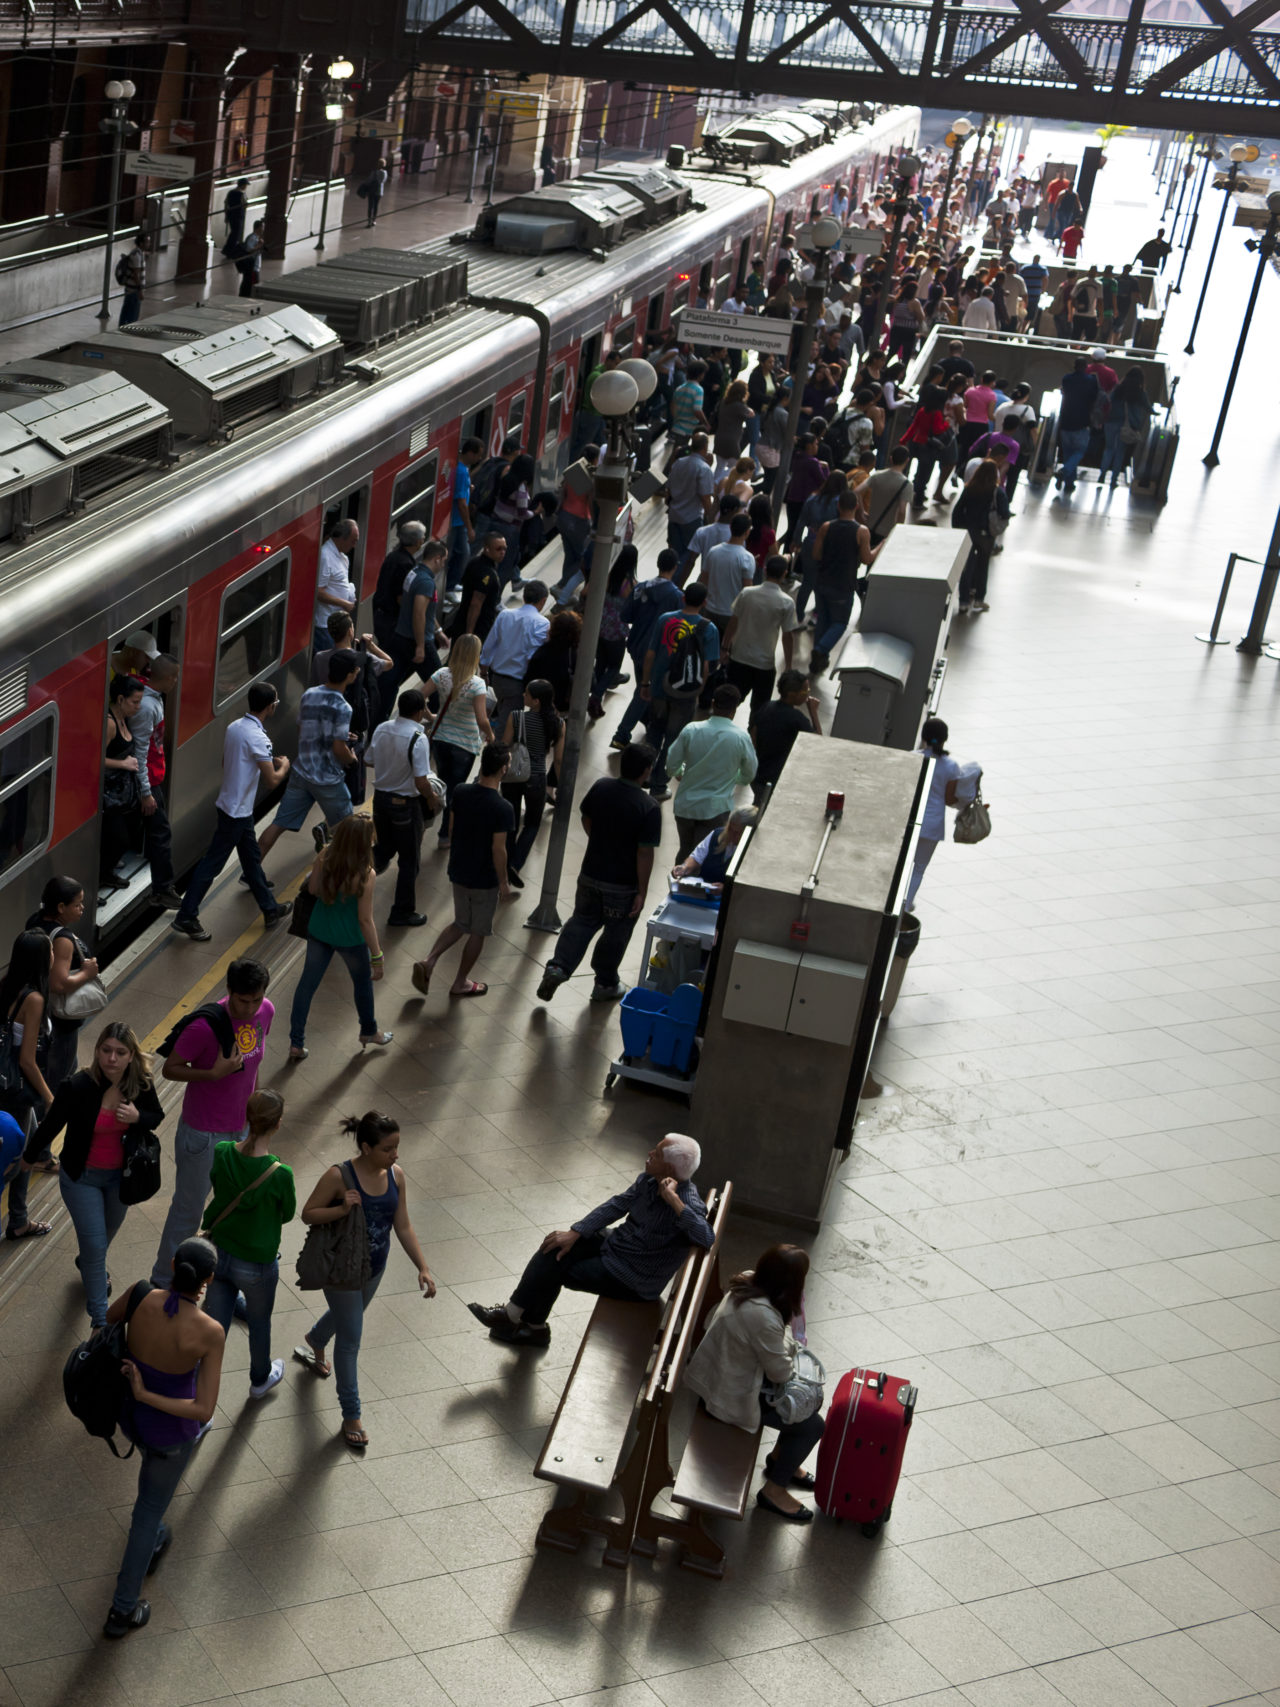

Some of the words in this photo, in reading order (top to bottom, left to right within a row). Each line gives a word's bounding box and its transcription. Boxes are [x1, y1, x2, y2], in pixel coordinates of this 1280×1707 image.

[686, 312, 731, 325] Plataforma
[684, 329, 721, 342] Somente
[723, 334, 782, 349] Desembarque
